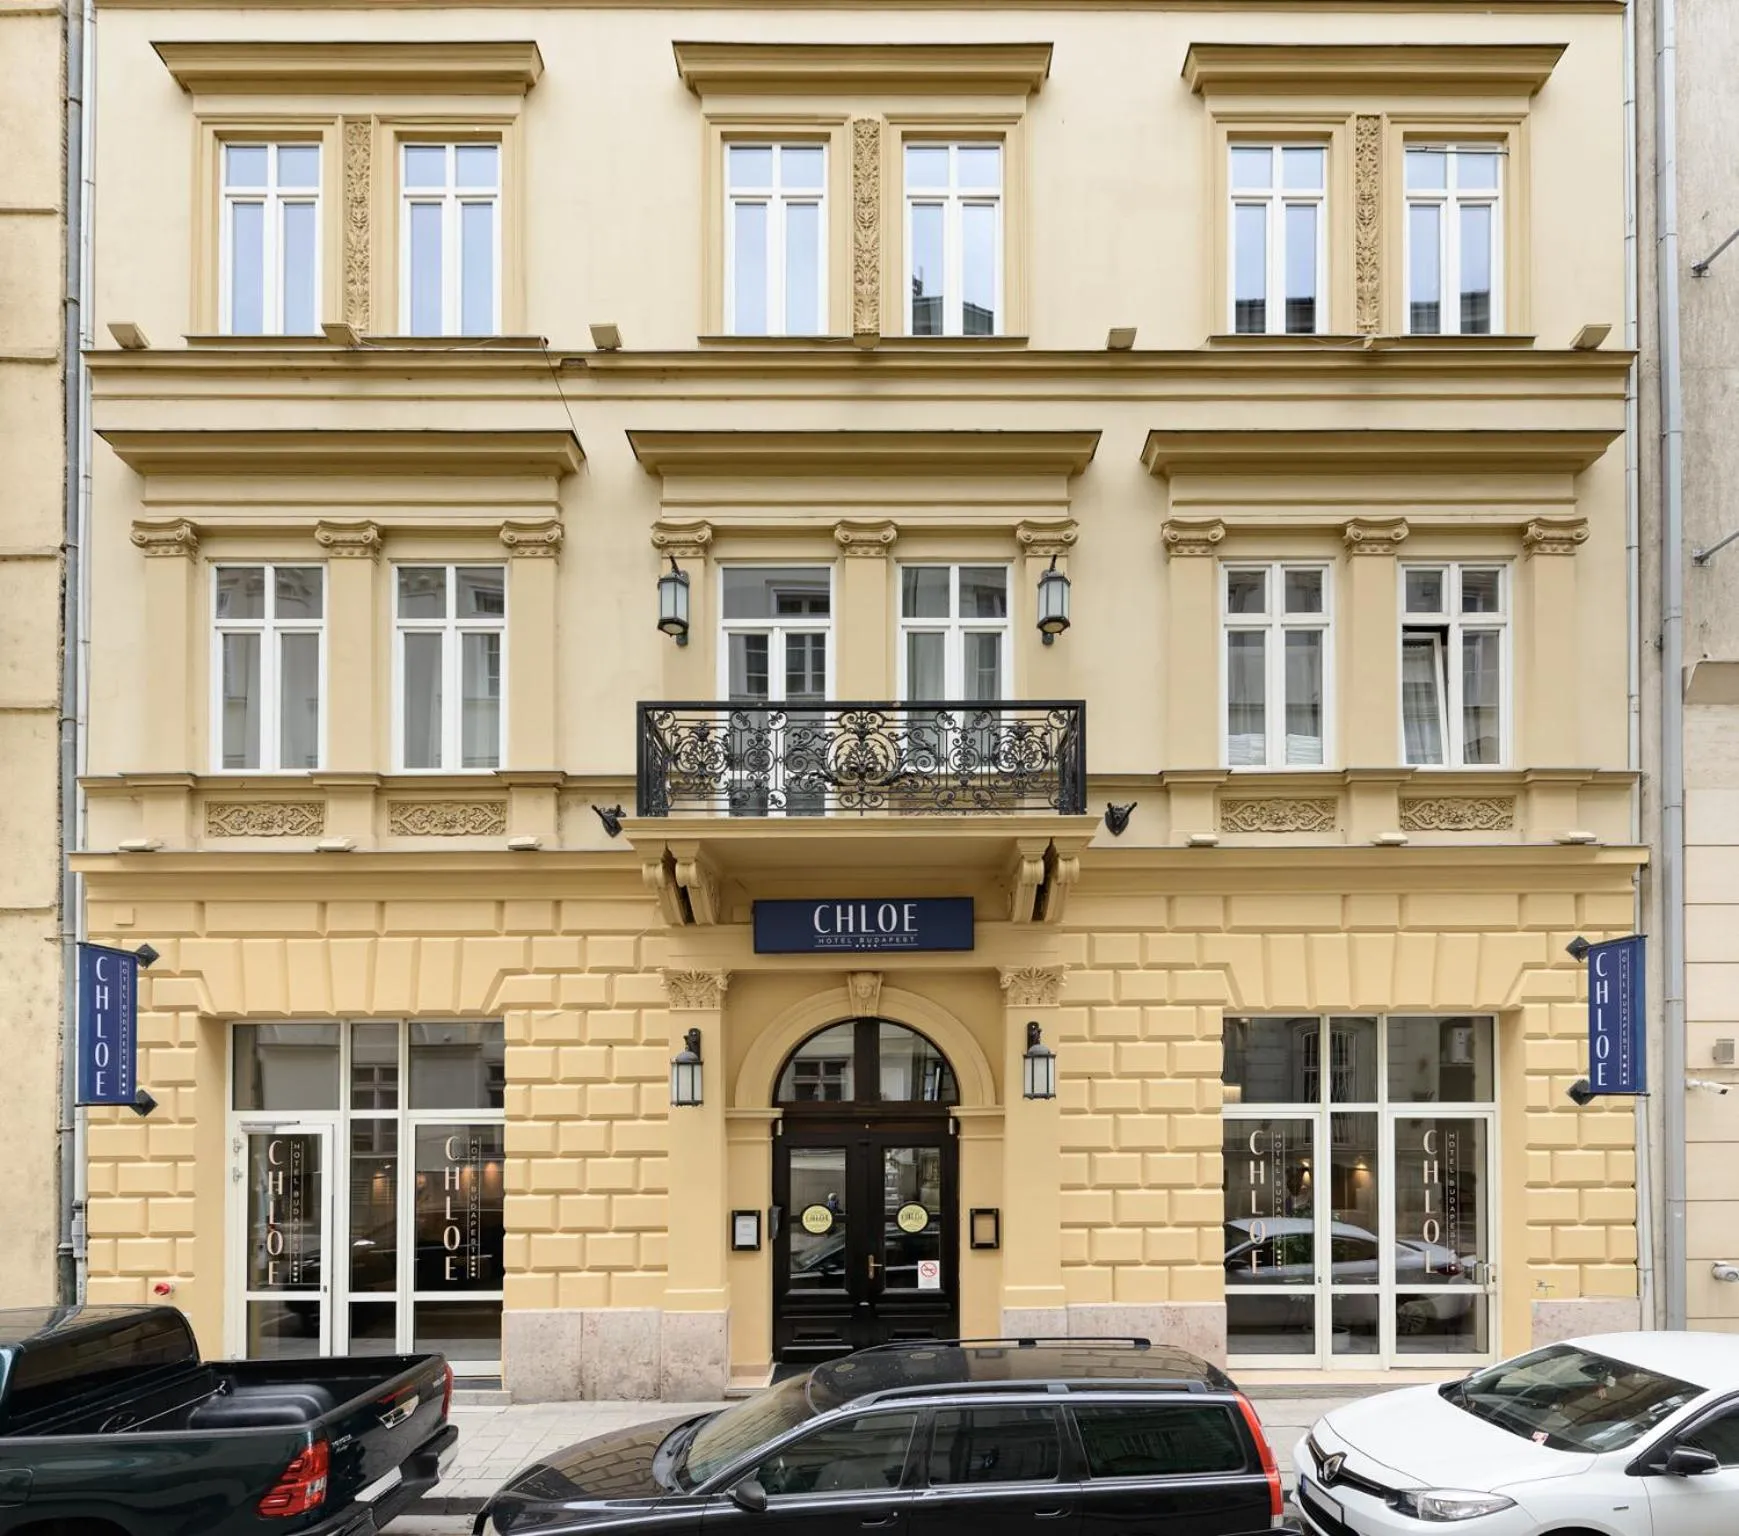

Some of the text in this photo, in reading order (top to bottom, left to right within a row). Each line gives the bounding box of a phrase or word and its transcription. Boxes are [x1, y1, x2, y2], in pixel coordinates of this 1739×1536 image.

[814, 903, 918, 933] CHLOE
[859, 936, 914, 944] BUDAPEST
[94, 956, 110, 1096] CHLOE
[1596, 952, 1610, 1086] CHLOE
[443, 1136, 461, 1280] CHLOE
[1249, 1130, 1266, 1274] CHLOE
